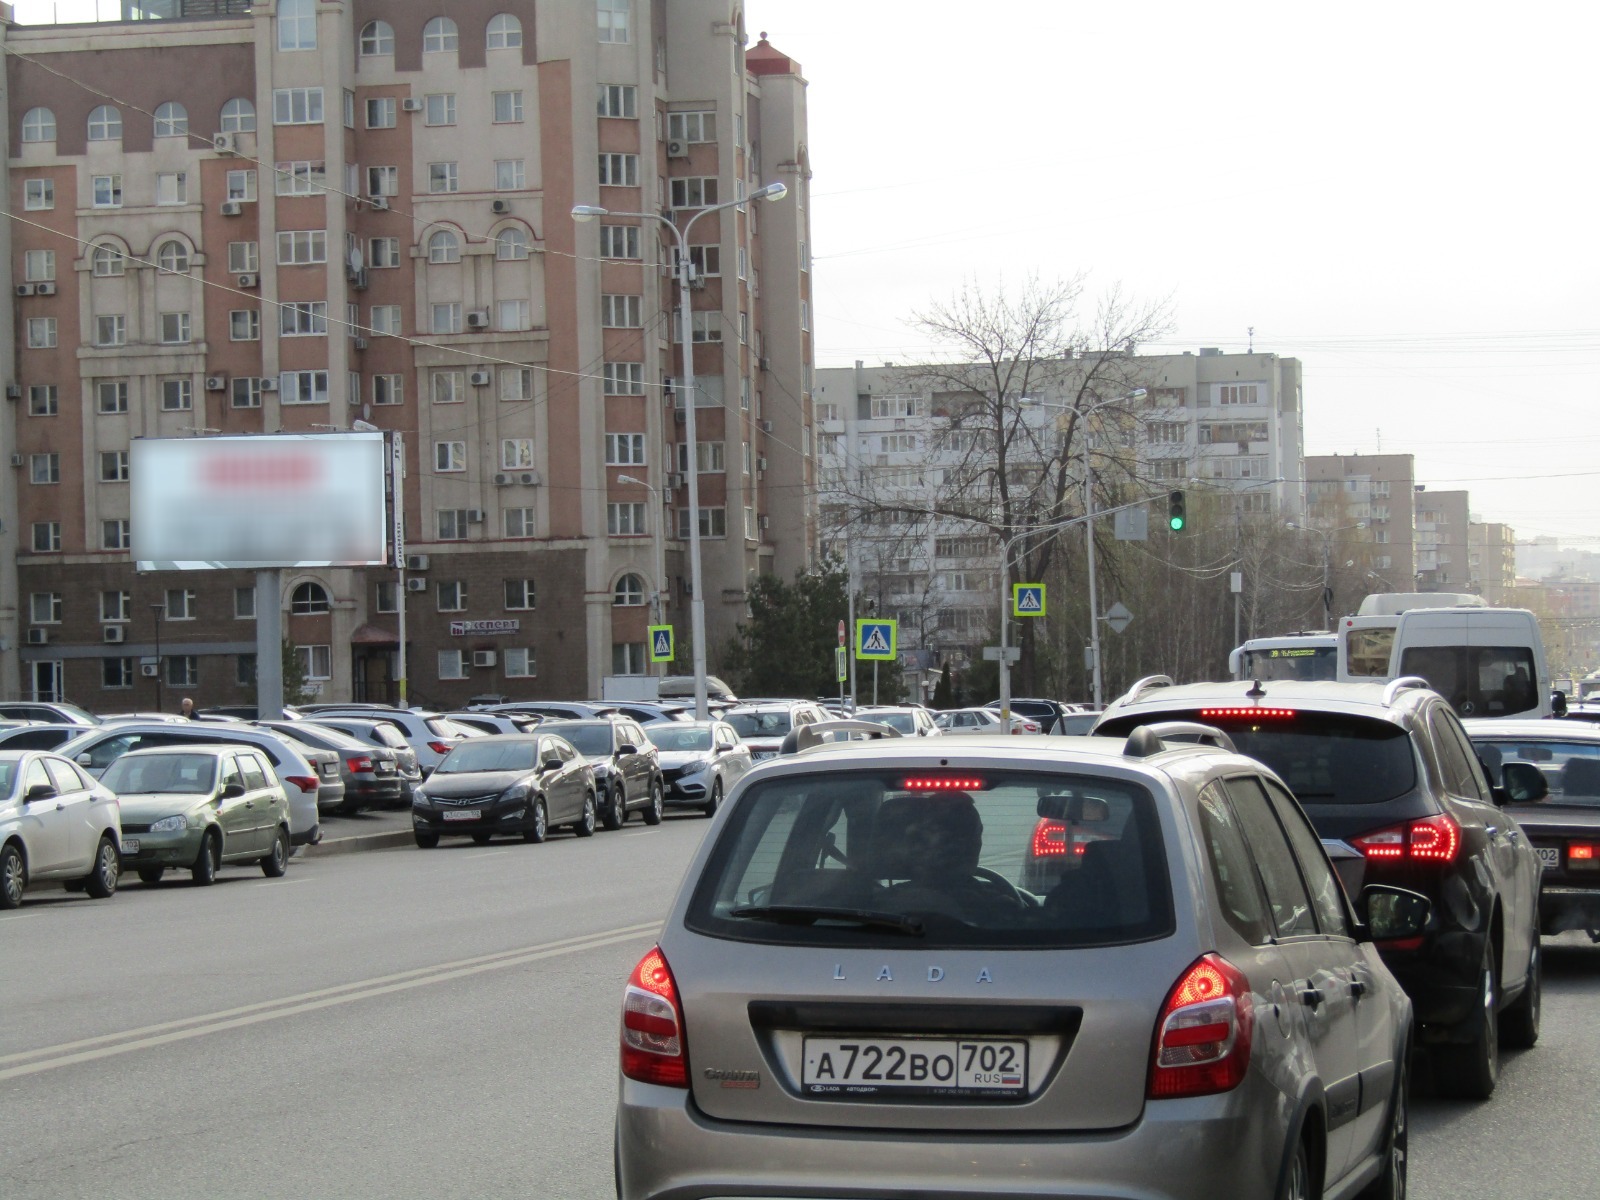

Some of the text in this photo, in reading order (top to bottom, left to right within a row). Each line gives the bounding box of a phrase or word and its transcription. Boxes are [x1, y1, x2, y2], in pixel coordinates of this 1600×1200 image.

[833, 963, 993, 984] LADA
[961, 1045, 1015, 1073] 702
[974, 1073, 1001, 1084] RUS
